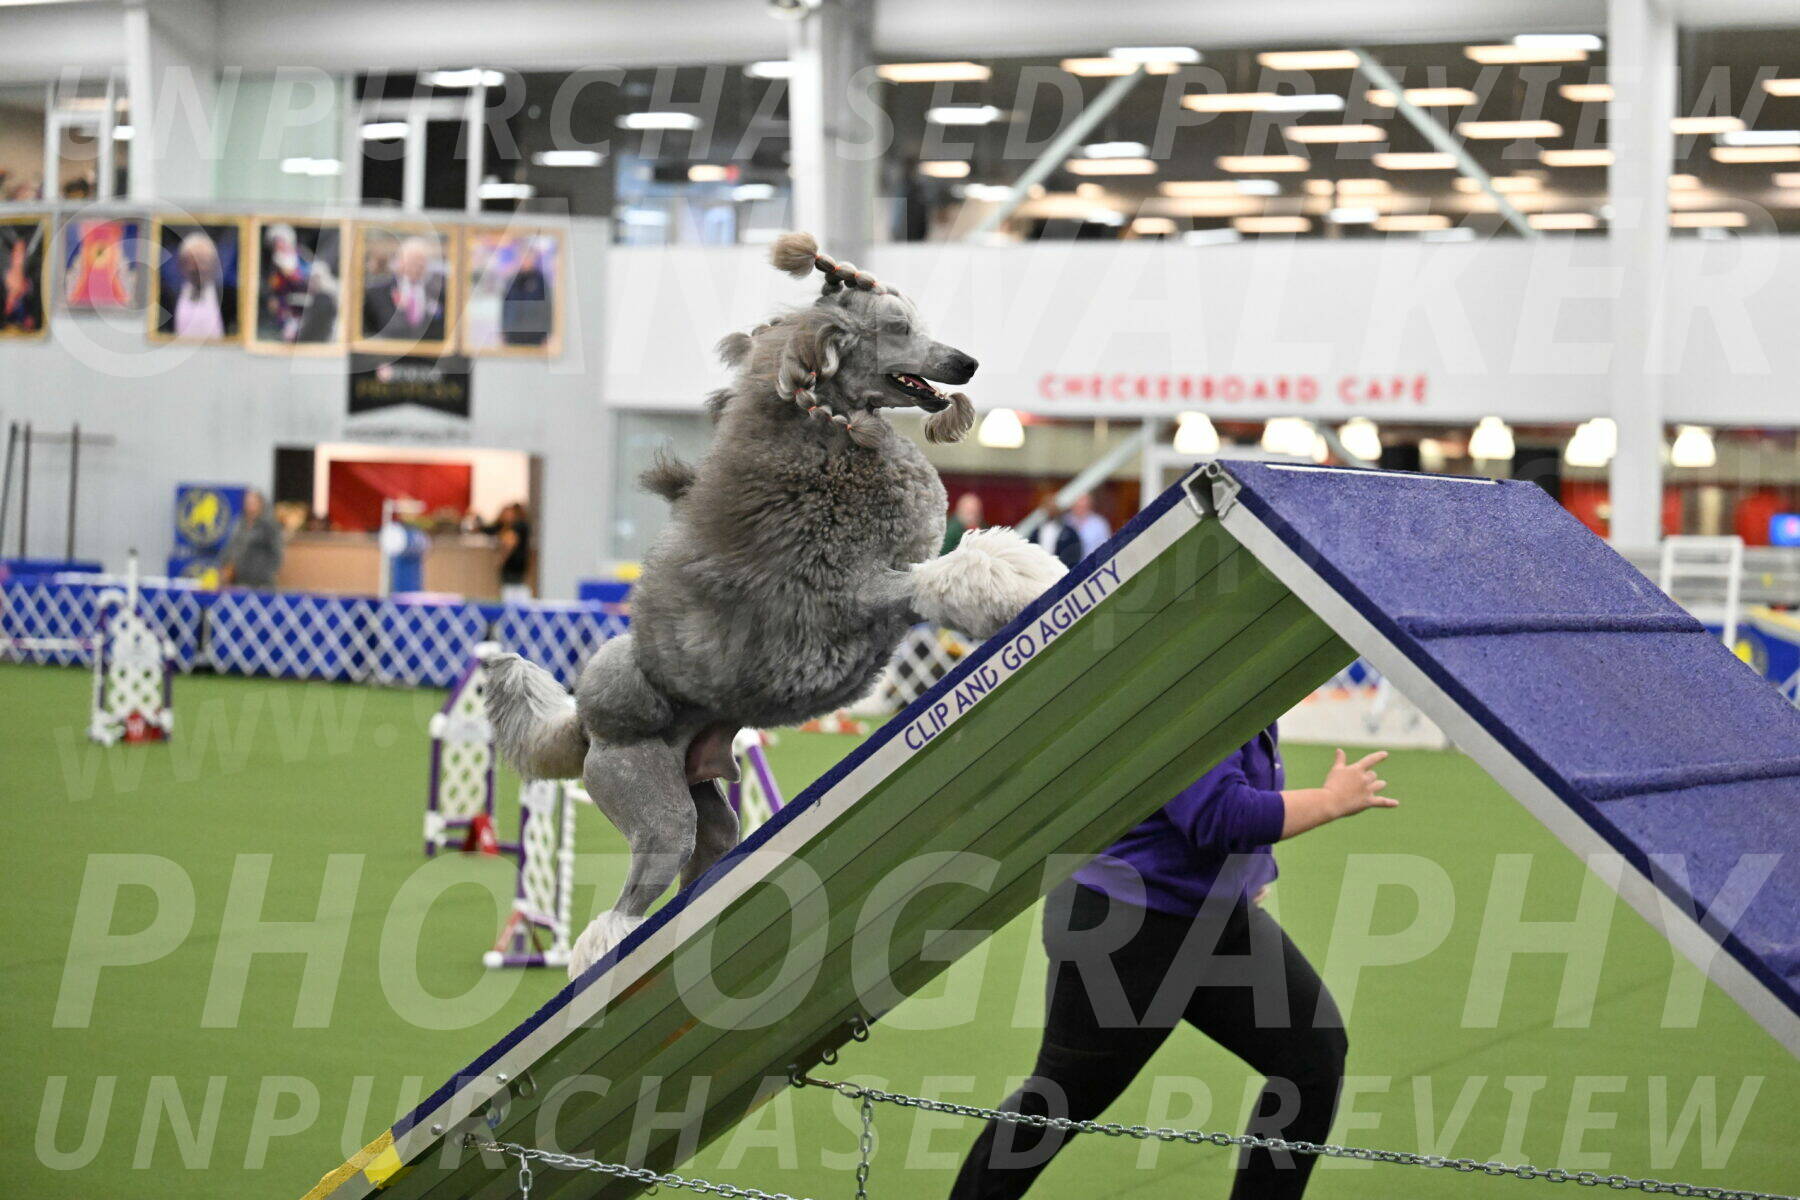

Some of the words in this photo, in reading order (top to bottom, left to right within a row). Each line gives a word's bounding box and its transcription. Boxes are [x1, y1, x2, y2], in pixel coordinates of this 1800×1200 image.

[1039, 374, 1318, 400] CHECKERBOARD
[905, 703, 949, 750] CLIP
[955, 665, 998, 714] AND
[1002, 634, 1036, 671] GO
[1040, 559, 1121, 643] AGILITY
